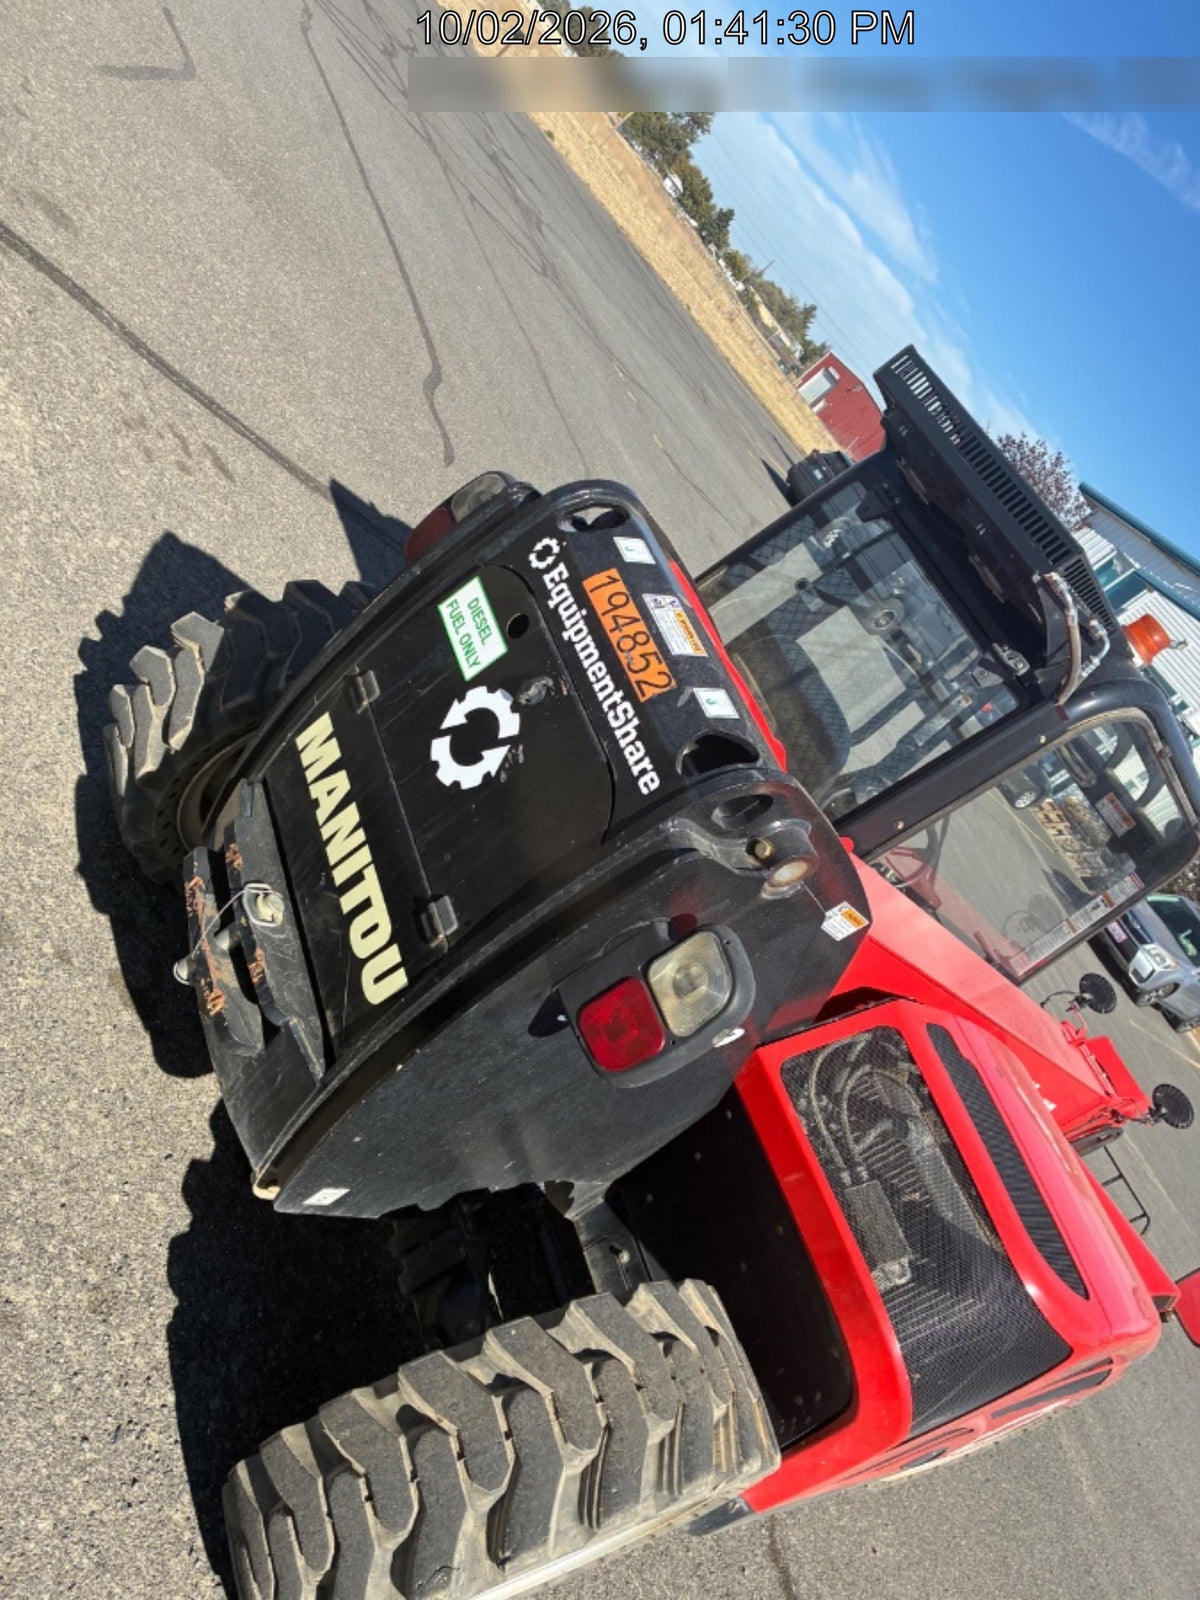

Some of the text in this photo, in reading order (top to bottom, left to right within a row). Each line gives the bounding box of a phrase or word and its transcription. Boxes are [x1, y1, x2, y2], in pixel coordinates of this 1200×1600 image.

[446, 599, 481, 669] FUEL ONLY
[468, 597, 493, 645] DIESEL
[542, 563, 660, 795] EquipmentShare
[588, 574, 672, 698] 194852
[295, 711, 409, 1006] MANITOU
